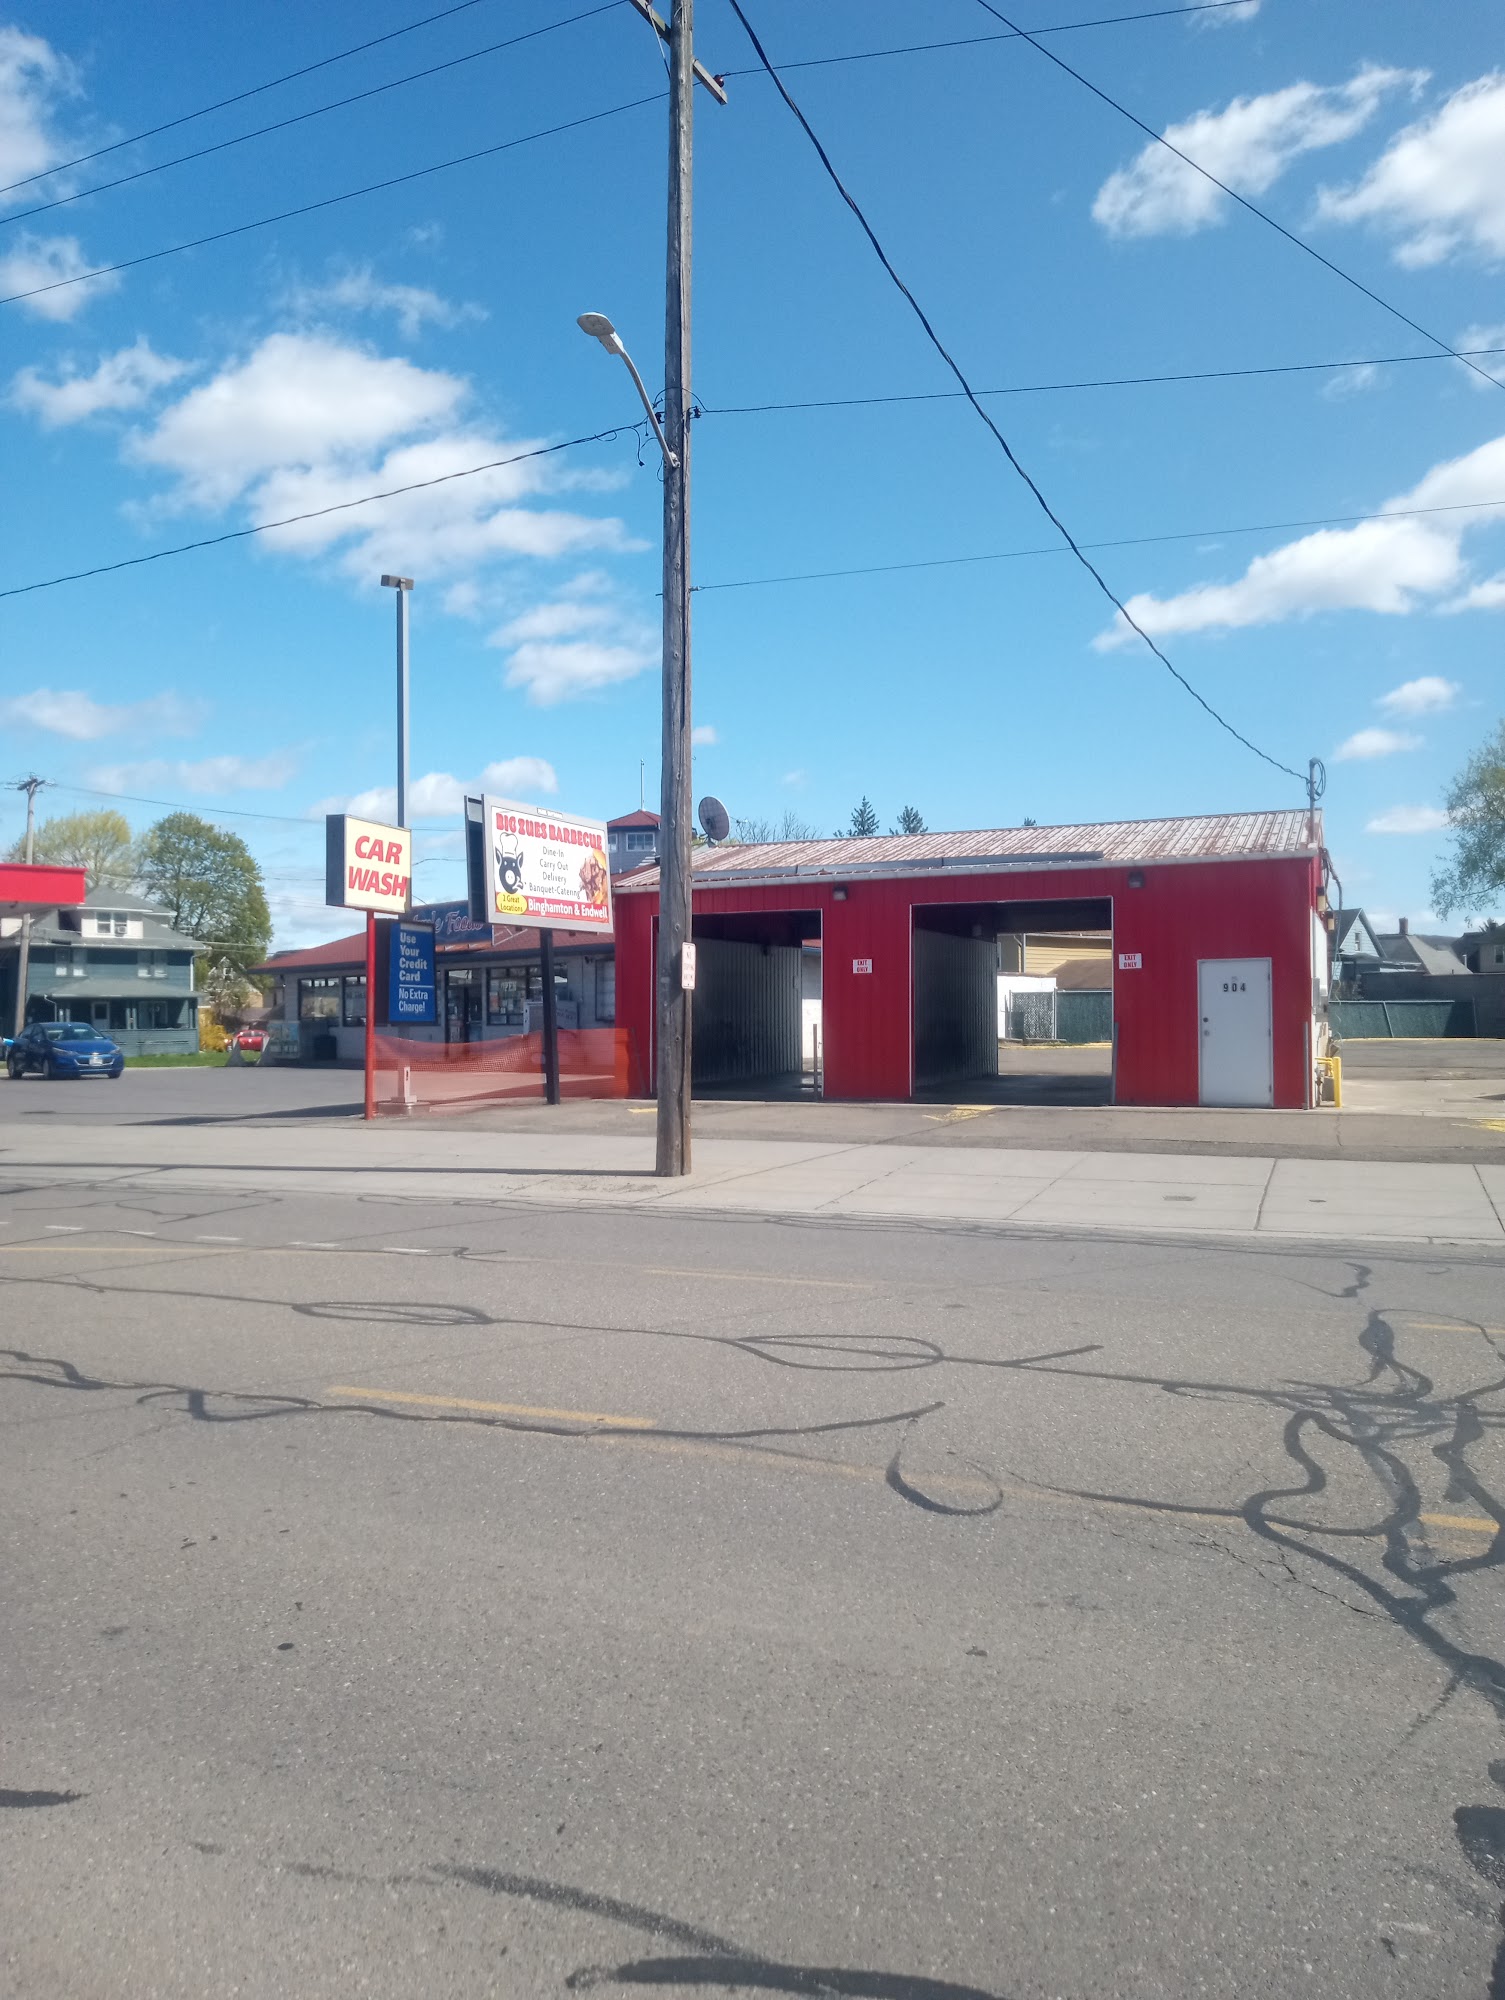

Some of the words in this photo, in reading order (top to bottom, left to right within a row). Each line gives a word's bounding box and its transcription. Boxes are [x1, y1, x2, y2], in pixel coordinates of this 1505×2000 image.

[496, 812, 516, 833] BIG
[518, 819, 547, 840] ZUES
[549, 824, 602, 850] BARBECUE
[355, 835, 402, 865] CAR
[543, 846, 564, 858] Dine-In
[540, 859, 556, 871] Carry
[557, 862, 568, 871] Out
[348, 866, 408, 898] WASH
[543, 872, 567, 885] Delivery
[529, 883, 580, 899] Banquet-Catering
[507, 895, 520, 904] Great
[500, 903, 523, 912] Locations
[528, 899, 573, 917] Binghamton
[574, 904, 580, 915] &
[581, 905, 608, 918] Endwell
[400, 933, 416, 944] Use
[400, 945, 419, 957] Your
[399, 958, 428, 970] Credit
[399, 970, 420, 982] Card
[1223, 983, 1246, 992] 904
[399, 988, 408, 999] No
[410, 988, 428, 1000] Extra
[399, 1001, 425, 1014] Charge!
